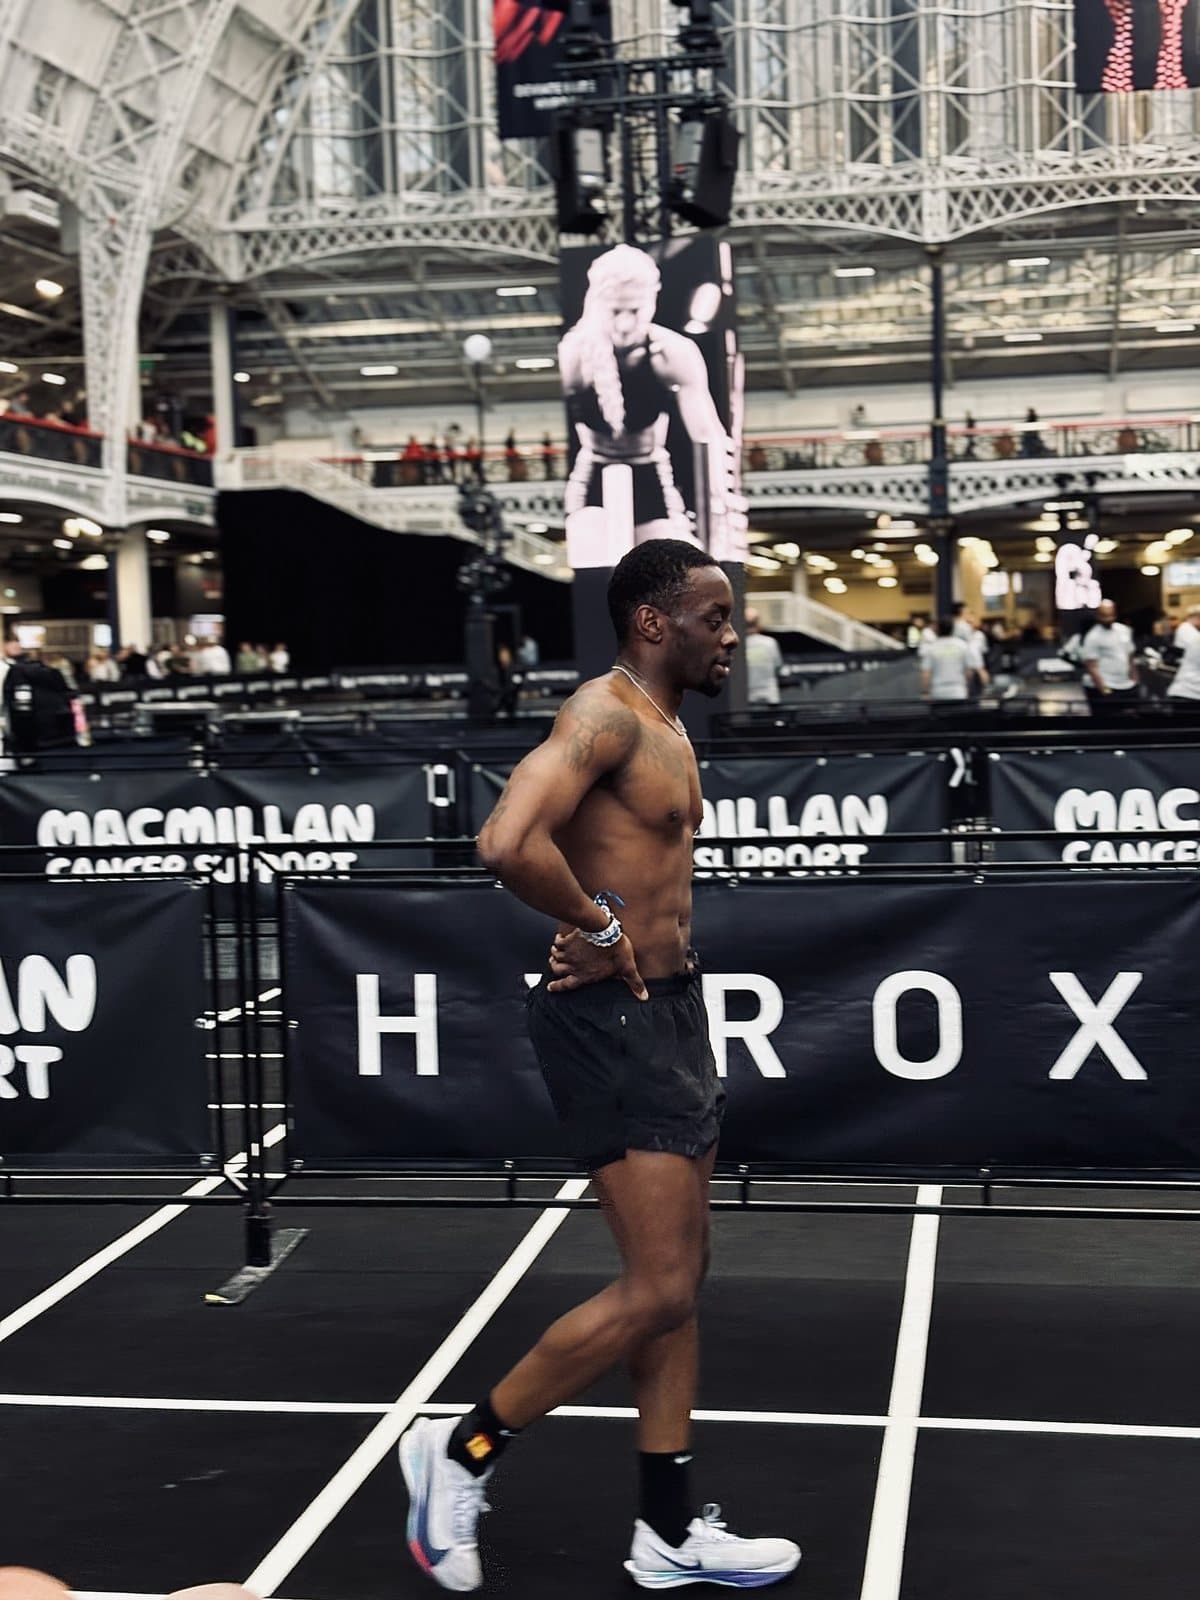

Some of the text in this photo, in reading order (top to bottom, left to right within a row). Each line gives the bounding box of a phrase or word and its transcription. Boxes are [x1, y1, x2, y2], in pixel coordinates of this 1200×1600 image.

[37, 803, 376, 848] MACMILLAN
[1061, 840, 1200, 872] CANCE
[355, 970, 1149, 1081] HROX
